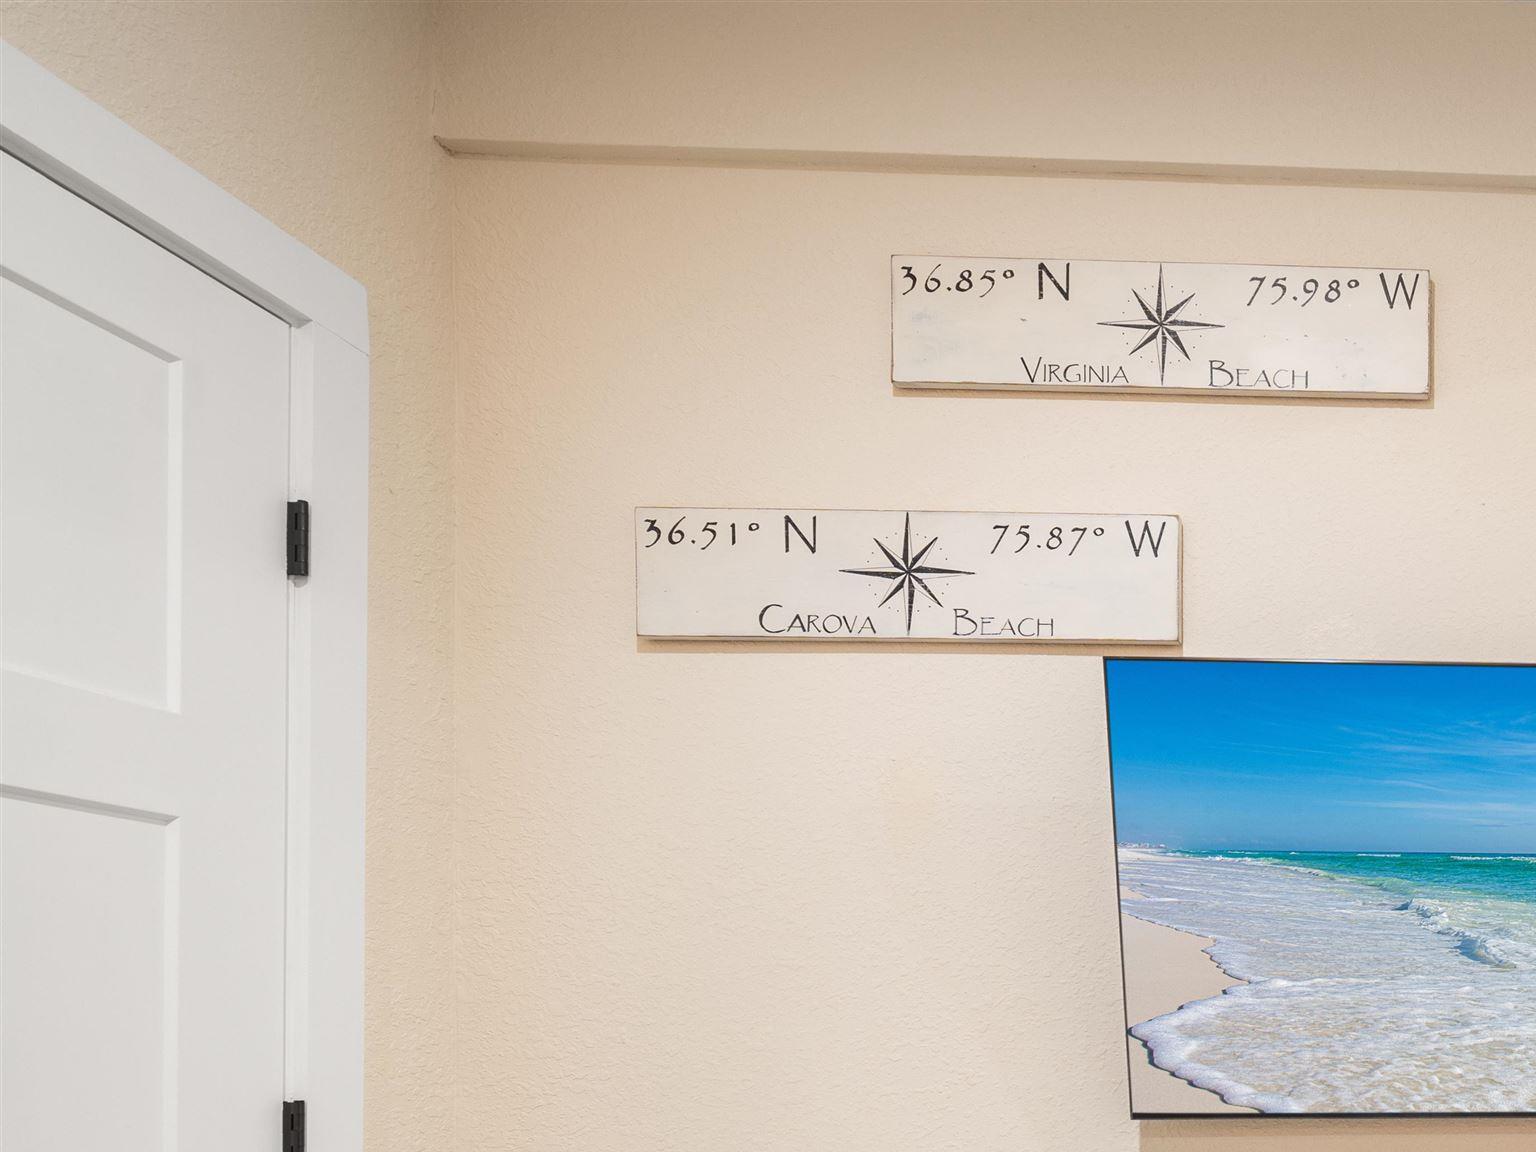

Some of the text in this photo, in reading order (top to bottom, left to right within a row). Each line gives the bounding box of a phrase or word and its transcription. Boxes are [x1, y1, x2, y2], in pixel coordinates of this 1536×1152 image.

[900, 263, 1420, 309] 36.85° N 75.98° W
[1020, 356, 1309, 389] VIRGINIA BEACH
[644, 515, 1166, 557] 36.51° N 75.87° W
[758, 604, 1054, 637] CAROVA BEACH
